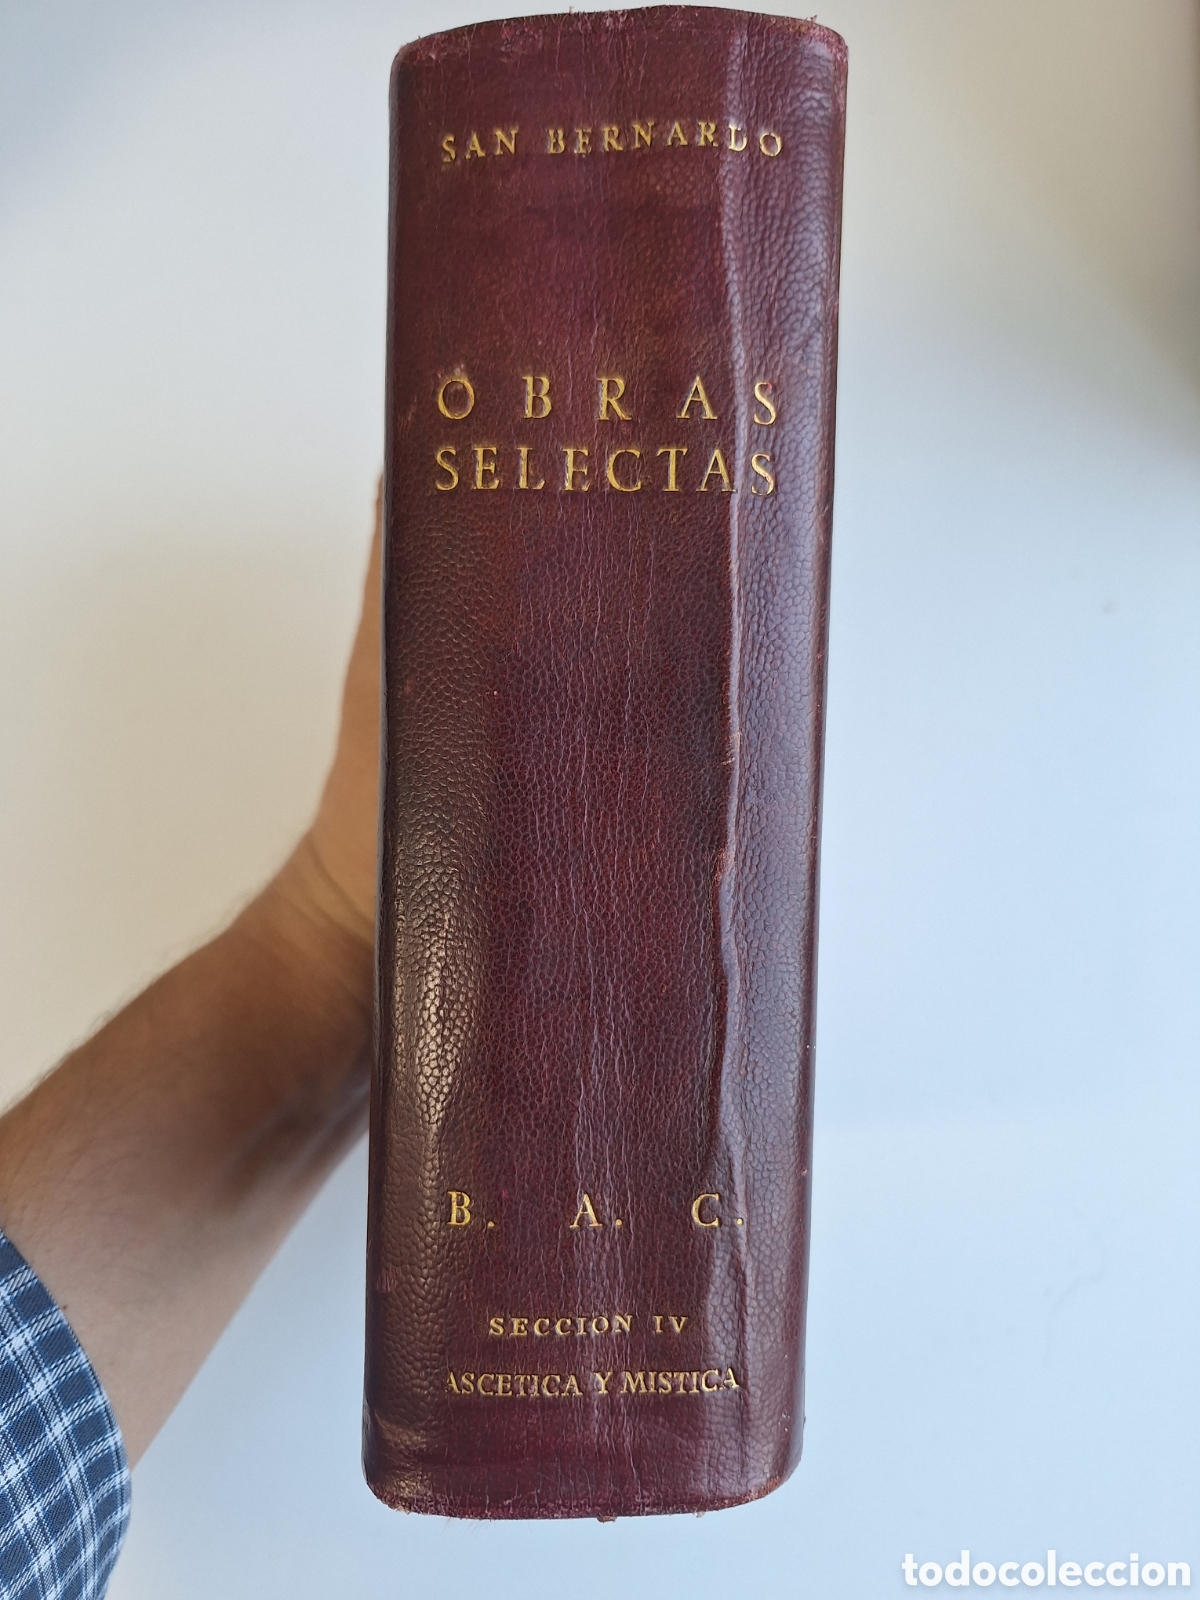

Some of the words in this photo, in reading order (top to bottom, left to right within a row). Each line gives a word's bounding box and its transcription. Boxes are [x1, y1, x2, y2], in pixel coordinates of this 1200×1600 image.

[441, 128, 519, 162] SAN
[547, 121, 783, 157] BERNARDO
[437, 376, 777, 426] OBRAS
[435, 446, 776, 496] SELECTAS
[488, 1315, 633, 1336] SECCION
[654, 1315, 689, 1334] IV
[445, 1371, 584, 1396] ASCETICA
[593, 1372, 617, 1394] Y
[620, 1366, 740, 1394] MISTICA
